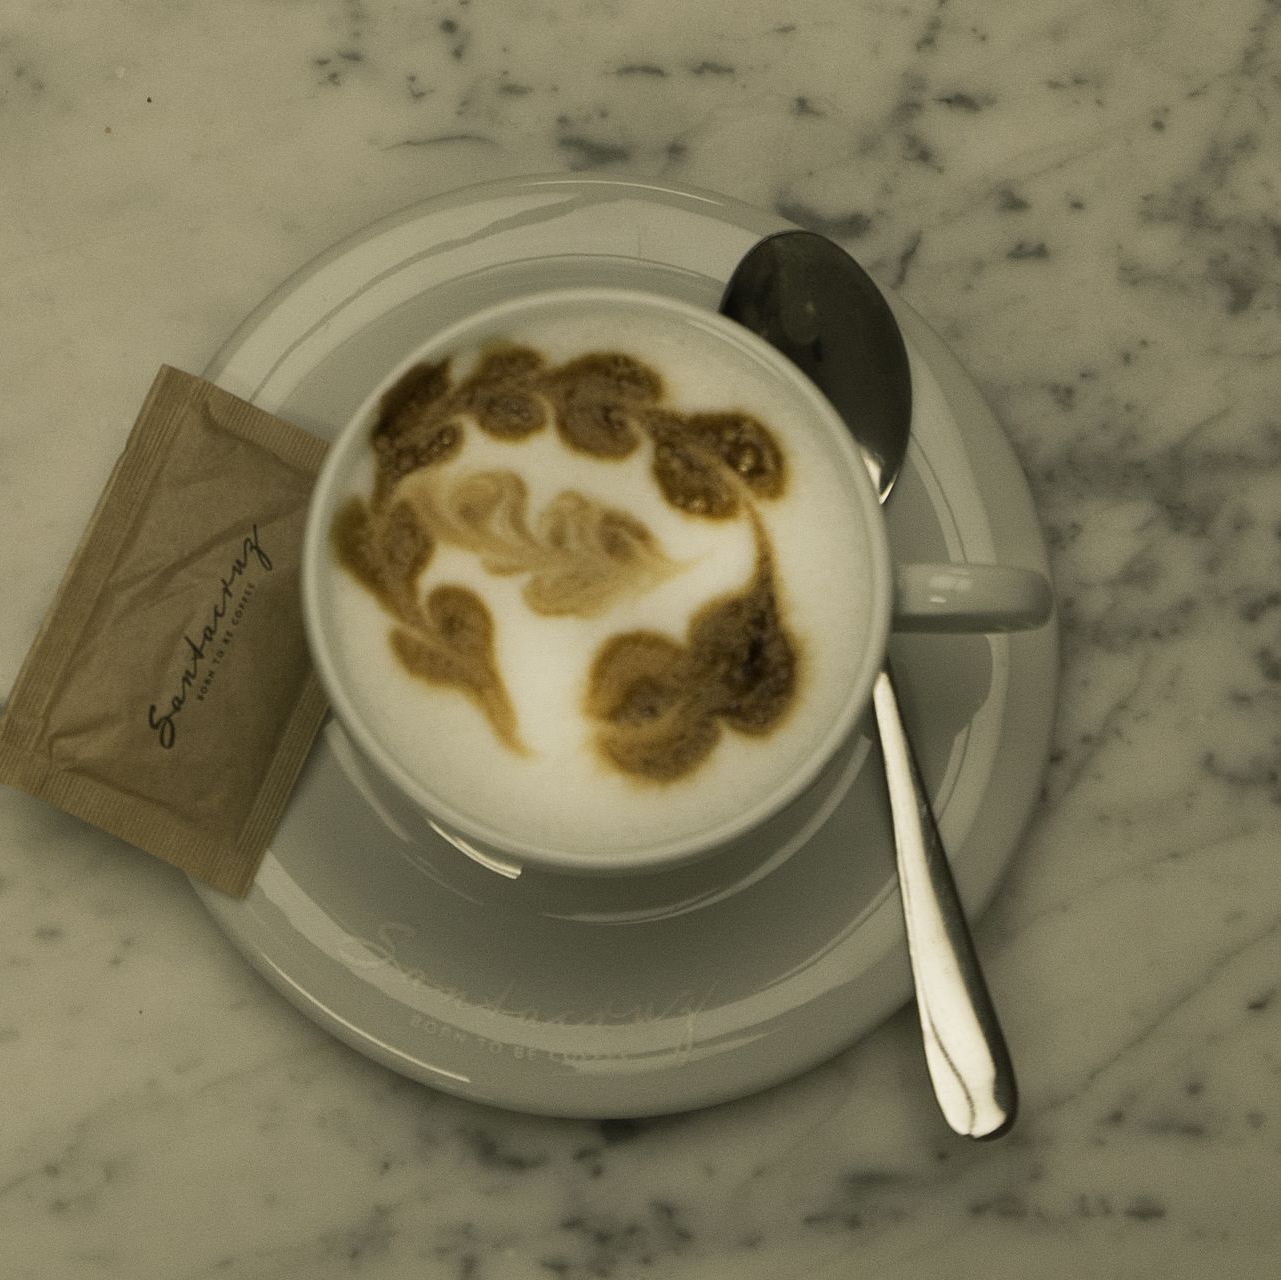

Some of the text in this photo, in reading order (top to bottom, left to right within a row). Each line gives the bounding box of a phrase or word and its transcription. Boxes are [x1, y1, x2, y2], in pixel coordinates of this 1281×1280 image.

[149, 523, 273, 750] Santacruz
[196, 670, 216, 702] BORN
[212, 650, 225, 666] TO
